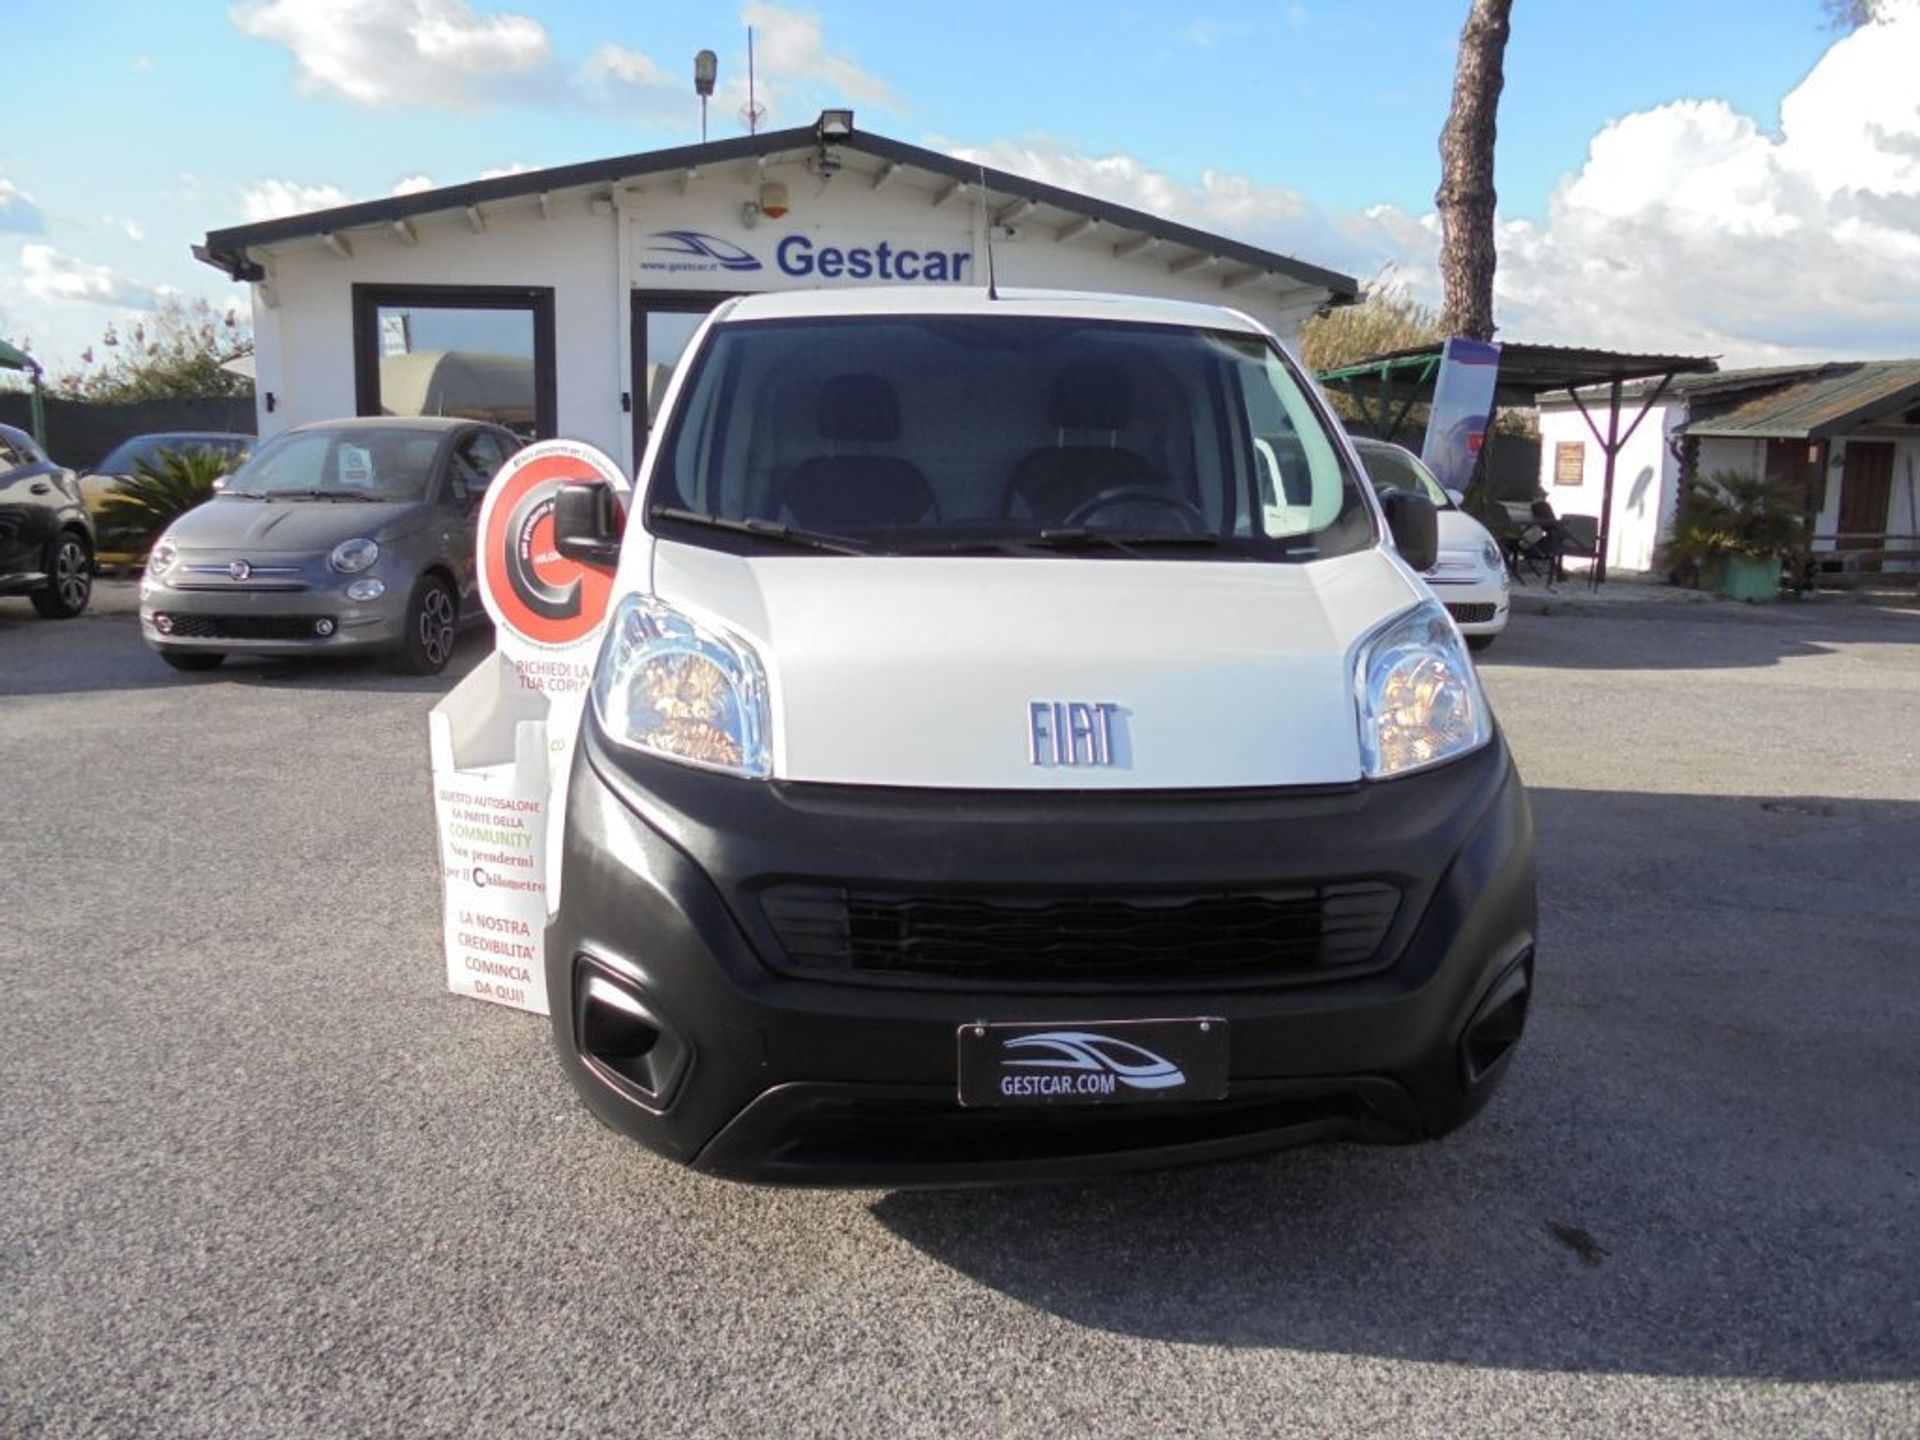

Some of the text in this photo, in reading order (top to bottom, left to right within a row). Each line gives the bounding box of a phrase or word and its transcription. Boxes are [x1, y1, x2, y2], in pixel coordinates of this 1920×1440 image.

[640, 260, 718, 274] www.gestcar.it
[777, 235, 971, 281] Gestcar
[516, 660, 590, 678] RICHIEDI LA
[519, 675, 545, 689] TUA
[1028, 702, 1118, 766] FIAT
[474, 795, 540, 813] AUTOSALONE
[464, 810, 492, 825] PARTE
[493, 816, 525, 829] DELLA
[450, 823, 532, 848] COMMUNITY
[472, 848, 534, 868] prendermi
[459, 909, 530, 937] LA NOSTRA
[458, 933, 536, 960] CREDIBILITA'
[465, 957, 531, 983] COMINCIA
[475, 980, 492, 996] DA
[1001, 1074, 1116, 1096] GESTCAR.COM
